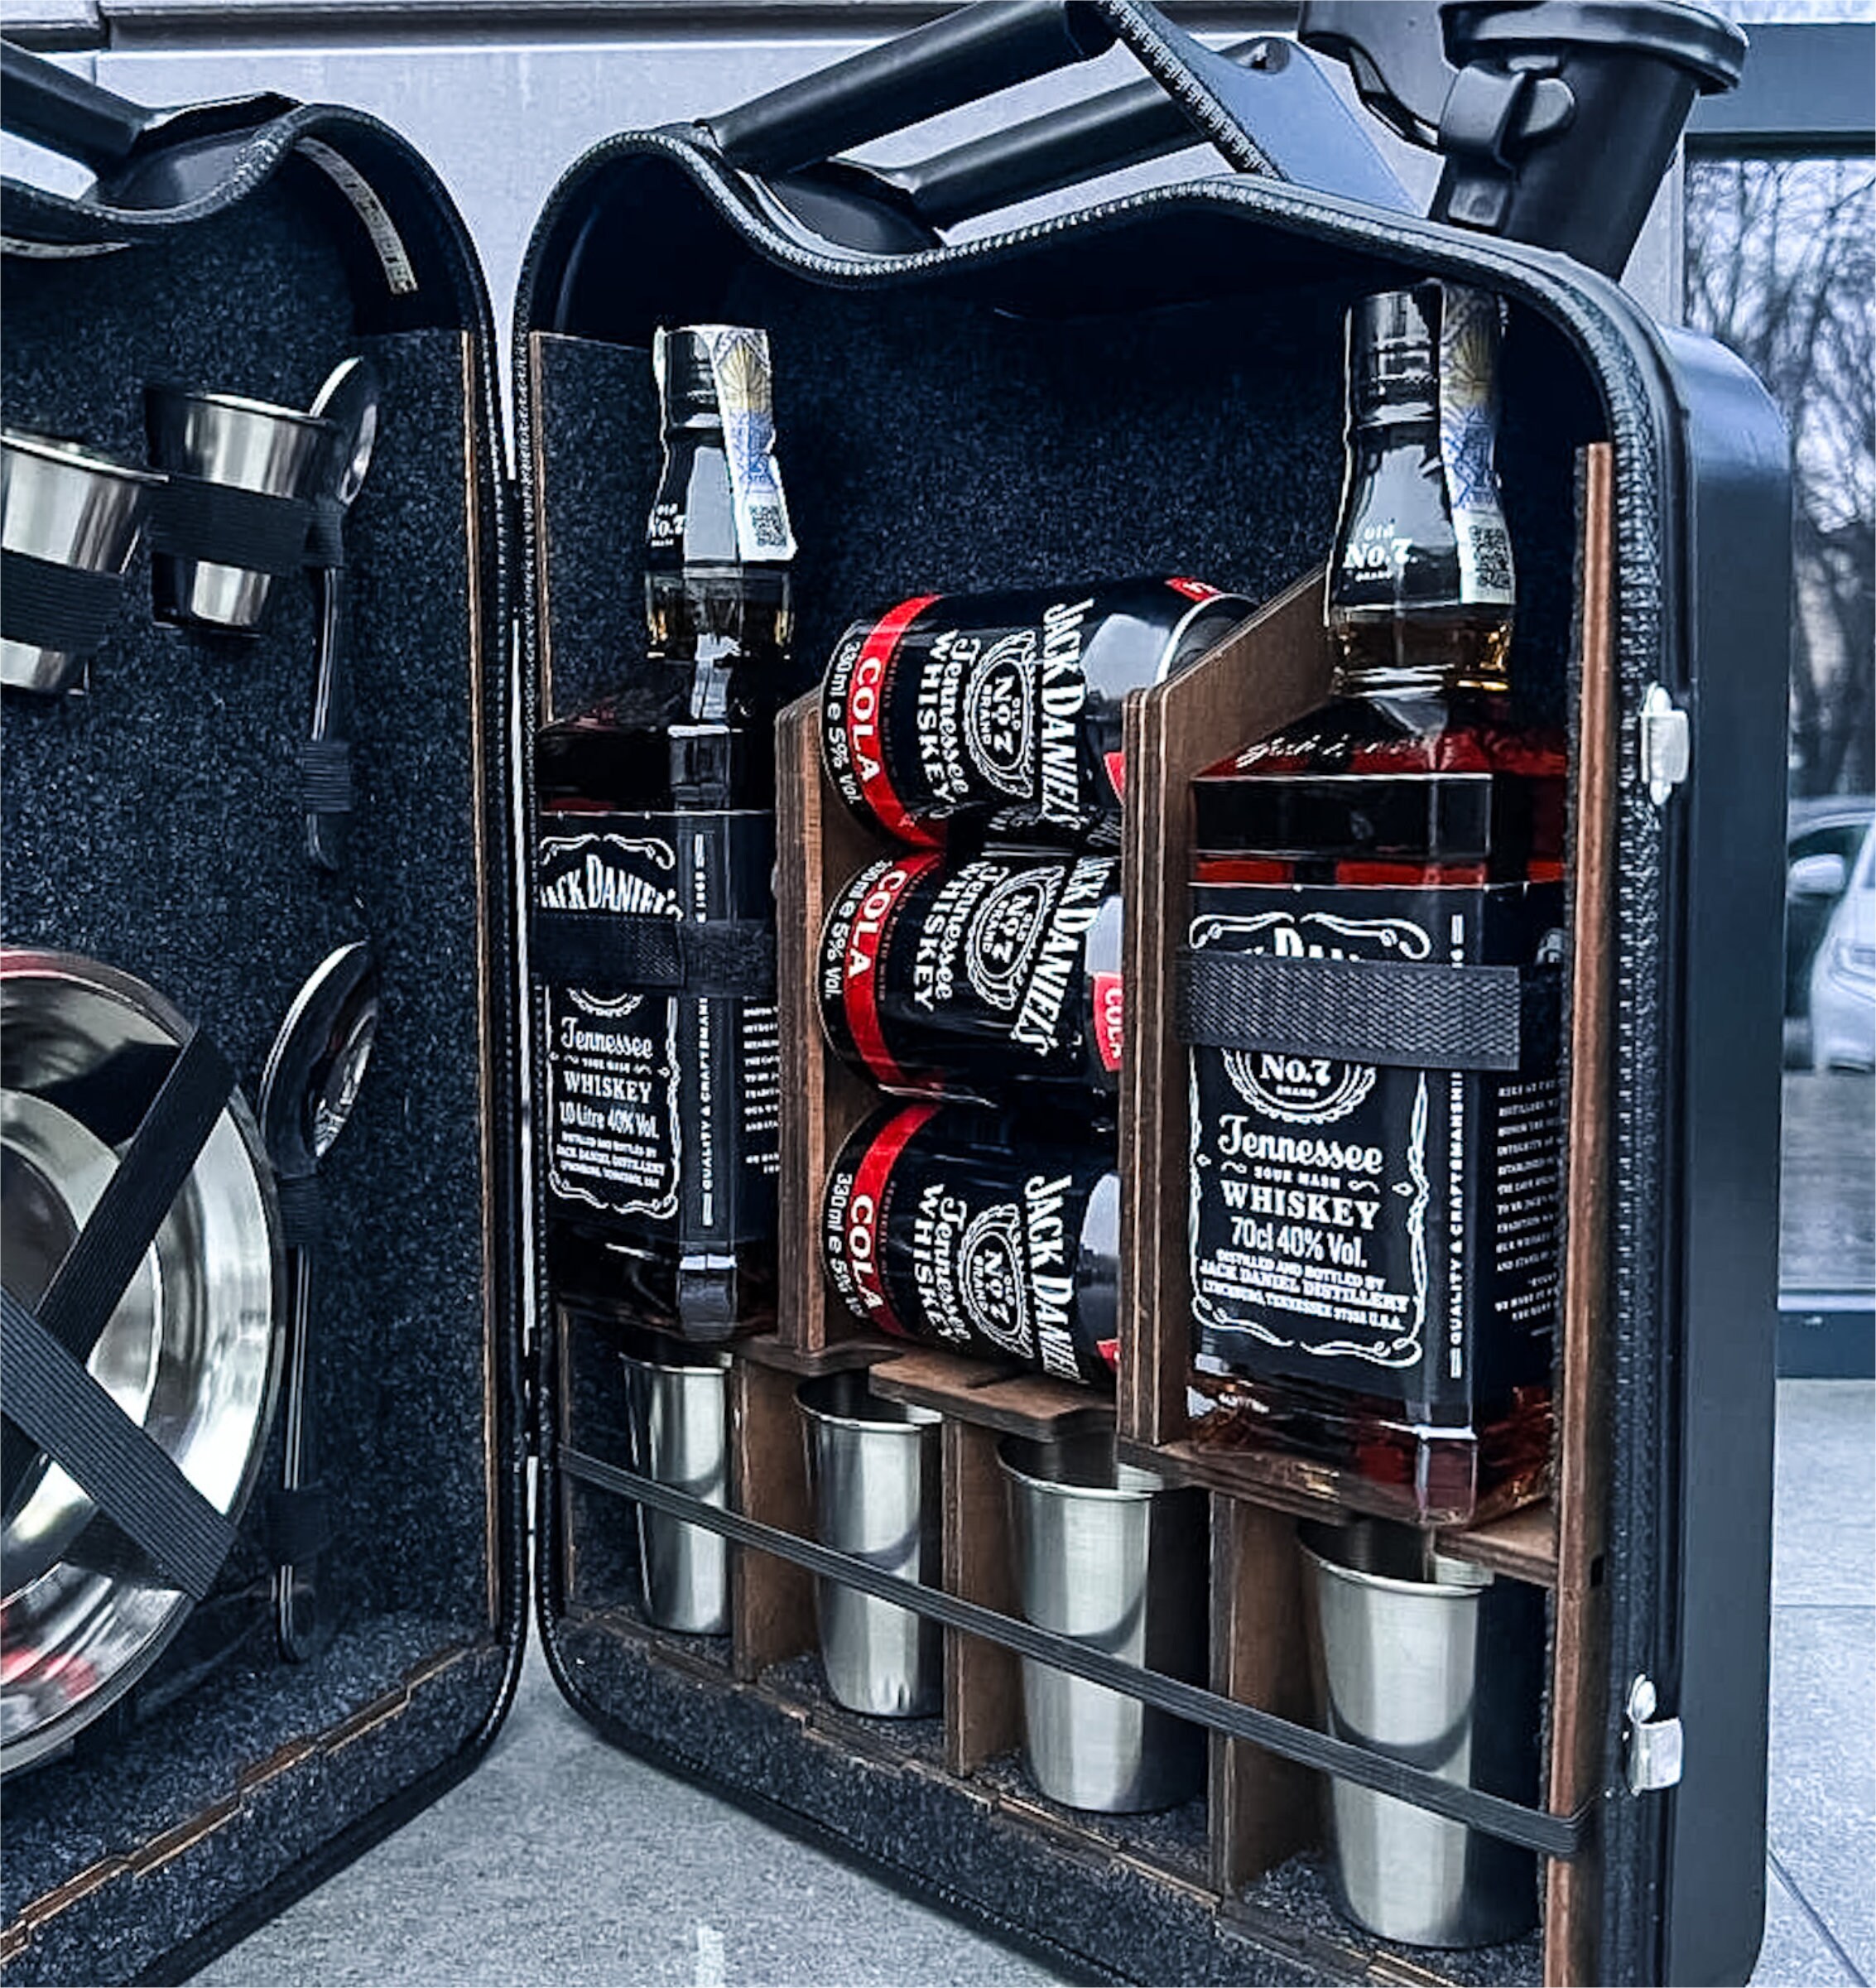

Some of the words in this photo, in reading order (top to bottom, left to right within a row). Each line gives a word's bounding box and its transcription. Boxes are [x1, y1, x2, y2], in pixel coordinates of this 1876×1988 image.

[1043, 598, 1094, 685] JACK
[829, 728, 849, 768] 5%
[852, 657, 882, 782] COLA
[917, 629, 959, 803] WHISKEY
[940, 637, 981, 793] Tennessee
[983, 685, 993, 745] BRAND
[1012, 700, 1022, 730] OLD
[827, 922, 850, 961] 5%
[849, 869, 907, 978] COLA
[914, 861, 991, 1012] WHISKEY
[936, 865, 1009, 999] Tennessee
[1010, 907, 1100, 1057] DANIEL'S
[560, 1017, 653, 1059] Tennessee
[1259, 1053, 1331, 1087] No.7
[563, 1070, 652, 1104] WHISKEY
[701, 1121, 713, 1191] QUALITY
[1218, 1114, 1384, 1174] Tennessee
[827, 1172, 853, 1231] 330ml
[1025, 1175, 1073, 1269] JACK
[1220, 1179, 1381, 1230] WHISKEY
[849, 1194, 884, 1310] COLA
[913, 1184, 960, 1343] WHISKEY
[934, 1196, 972, 1341] Tennessee
[1200, 1259, 1238, 1281] JACK
[1230, 1216, 1273, 1253] 70cl
[1277, 1226, 1325, 1262] 40%
[1326, 1232, 1368, 1268] Vol.
[1449, 1259, 1463, 1345] QUALITY
